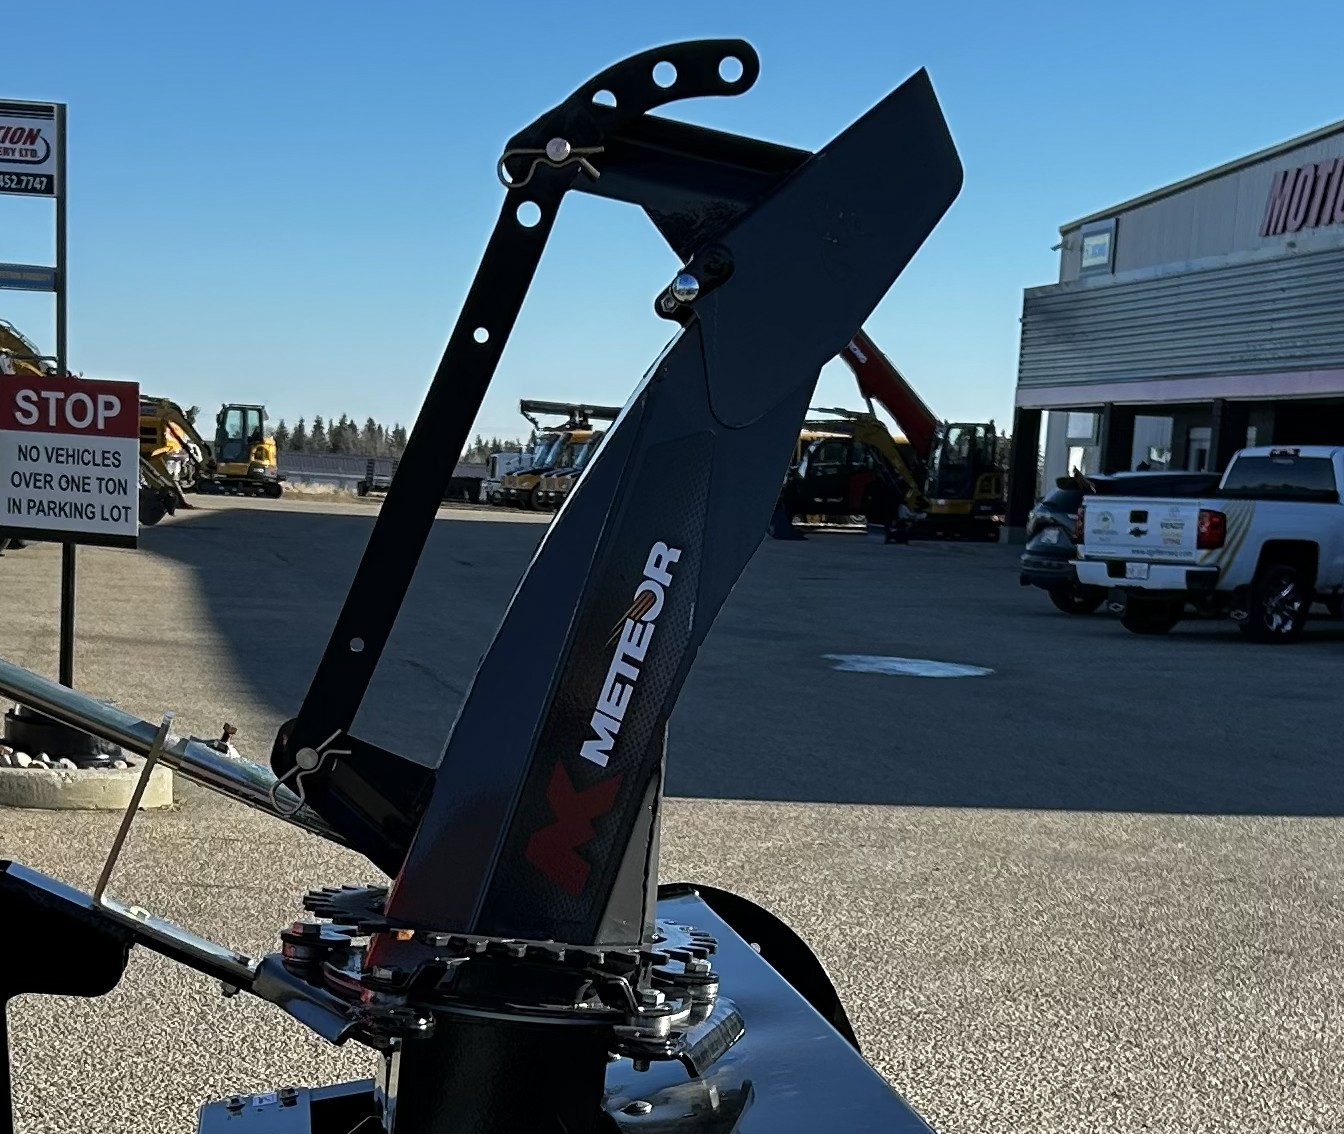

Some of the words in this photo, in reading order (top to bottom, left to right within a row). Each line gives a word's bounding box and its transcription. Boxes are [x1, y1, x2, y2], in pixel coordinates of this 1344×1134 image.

[14, 389, 122, 430] STOP
[17, 444, 41, 463] NO
[44, 446, 122, 469] VEHICLES
[10, 470, 54, 491] OVER
[58, 474, 92, 493] ONE
[96, 477, 128, 496] TON
[7, 497, 22, 515] IN
[27, 498, 96, 521] PARKING
[101, 504, 132, 523] LOT
[580, 541, 682, 767] METEOR
